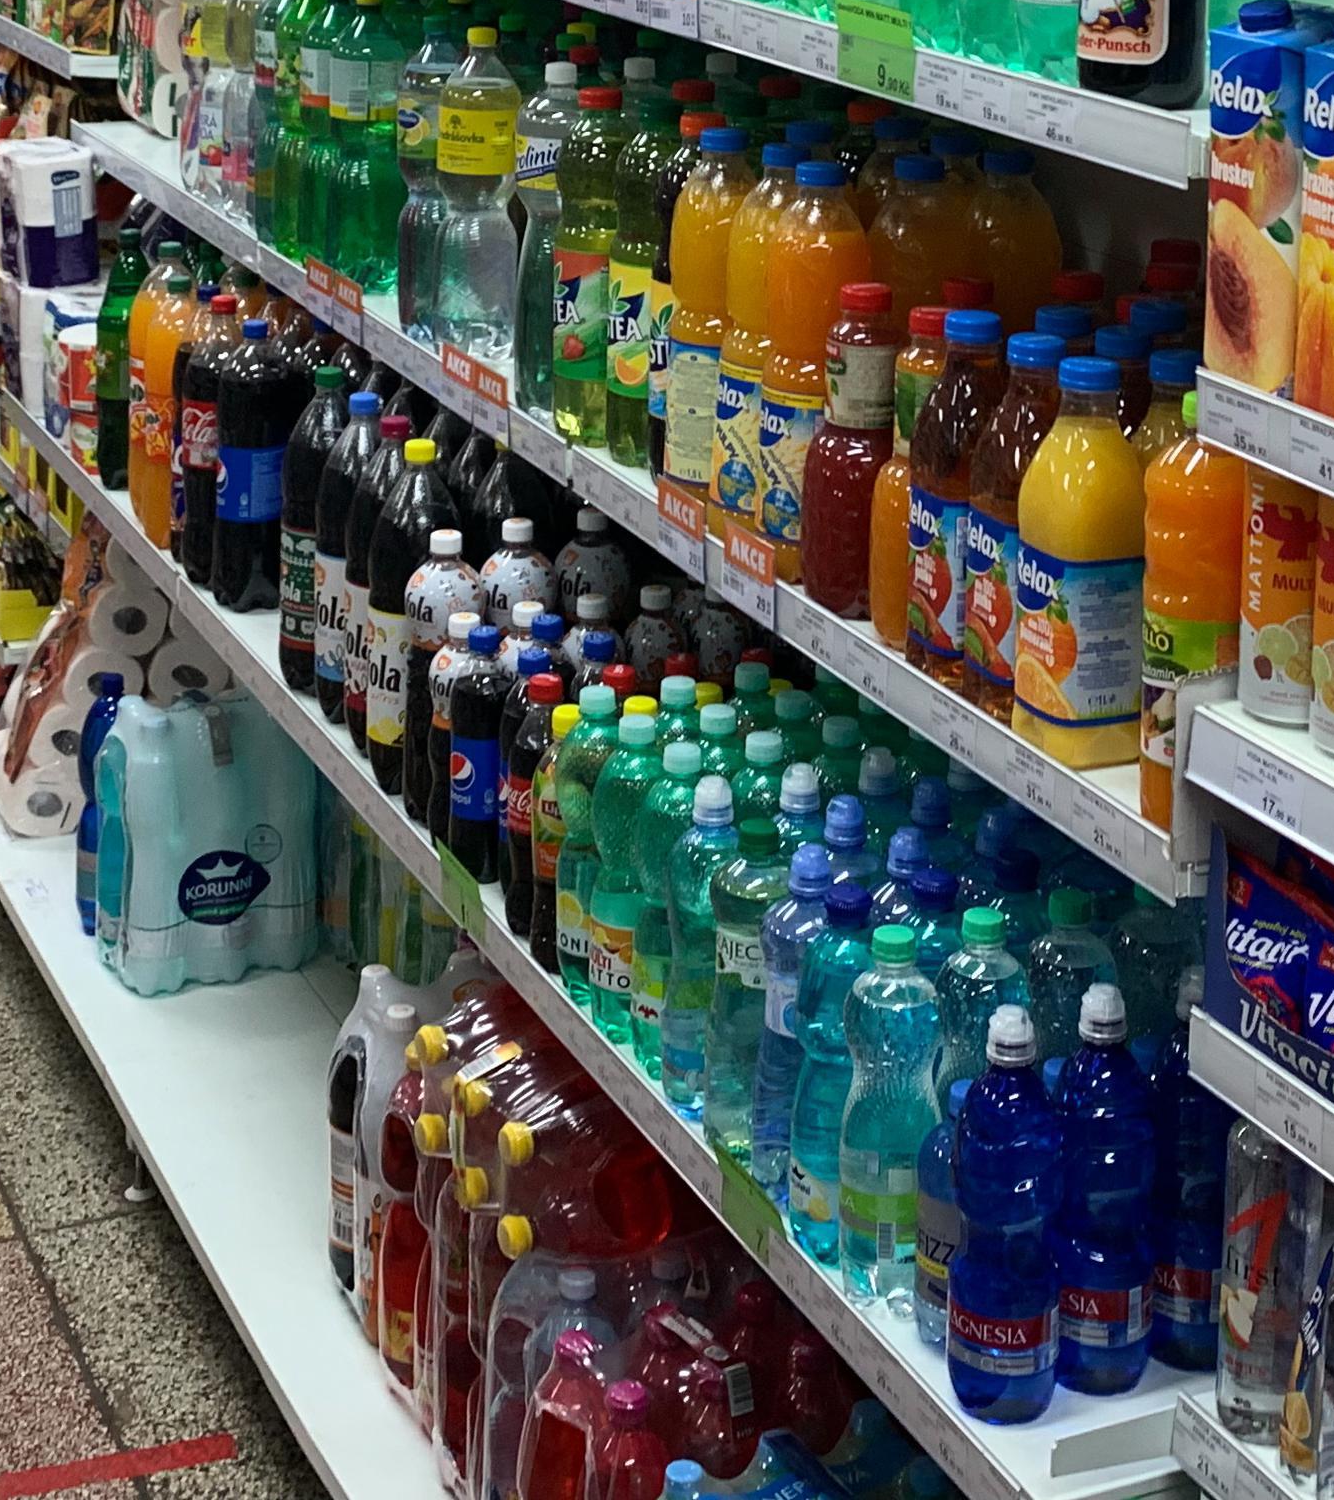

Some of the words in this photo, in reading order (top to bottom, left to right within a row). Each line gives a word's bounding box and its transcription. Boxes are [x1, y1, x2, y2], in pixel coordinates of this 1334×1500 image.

[1078, 35, 1152, 55] der-Punsch
[1211, 69, 1274, 120] Relax
[445, 352, 474, 381] AKCE
[478, 371, 504, 401] AKCE
[718, 378, 750, 412] elax
[664, 497, 698, 532] AKCE
[908, 495, 940, 540] elax
[729, 537, 767, 574] AKCE
[1246, 480, 1266, 613] MATTONI
[1017, 543, 1067, 603] Relax
[184, 870, 254, 903] KORUNNÍ
[950, 1308, 1027, 1347] AGNESIA
